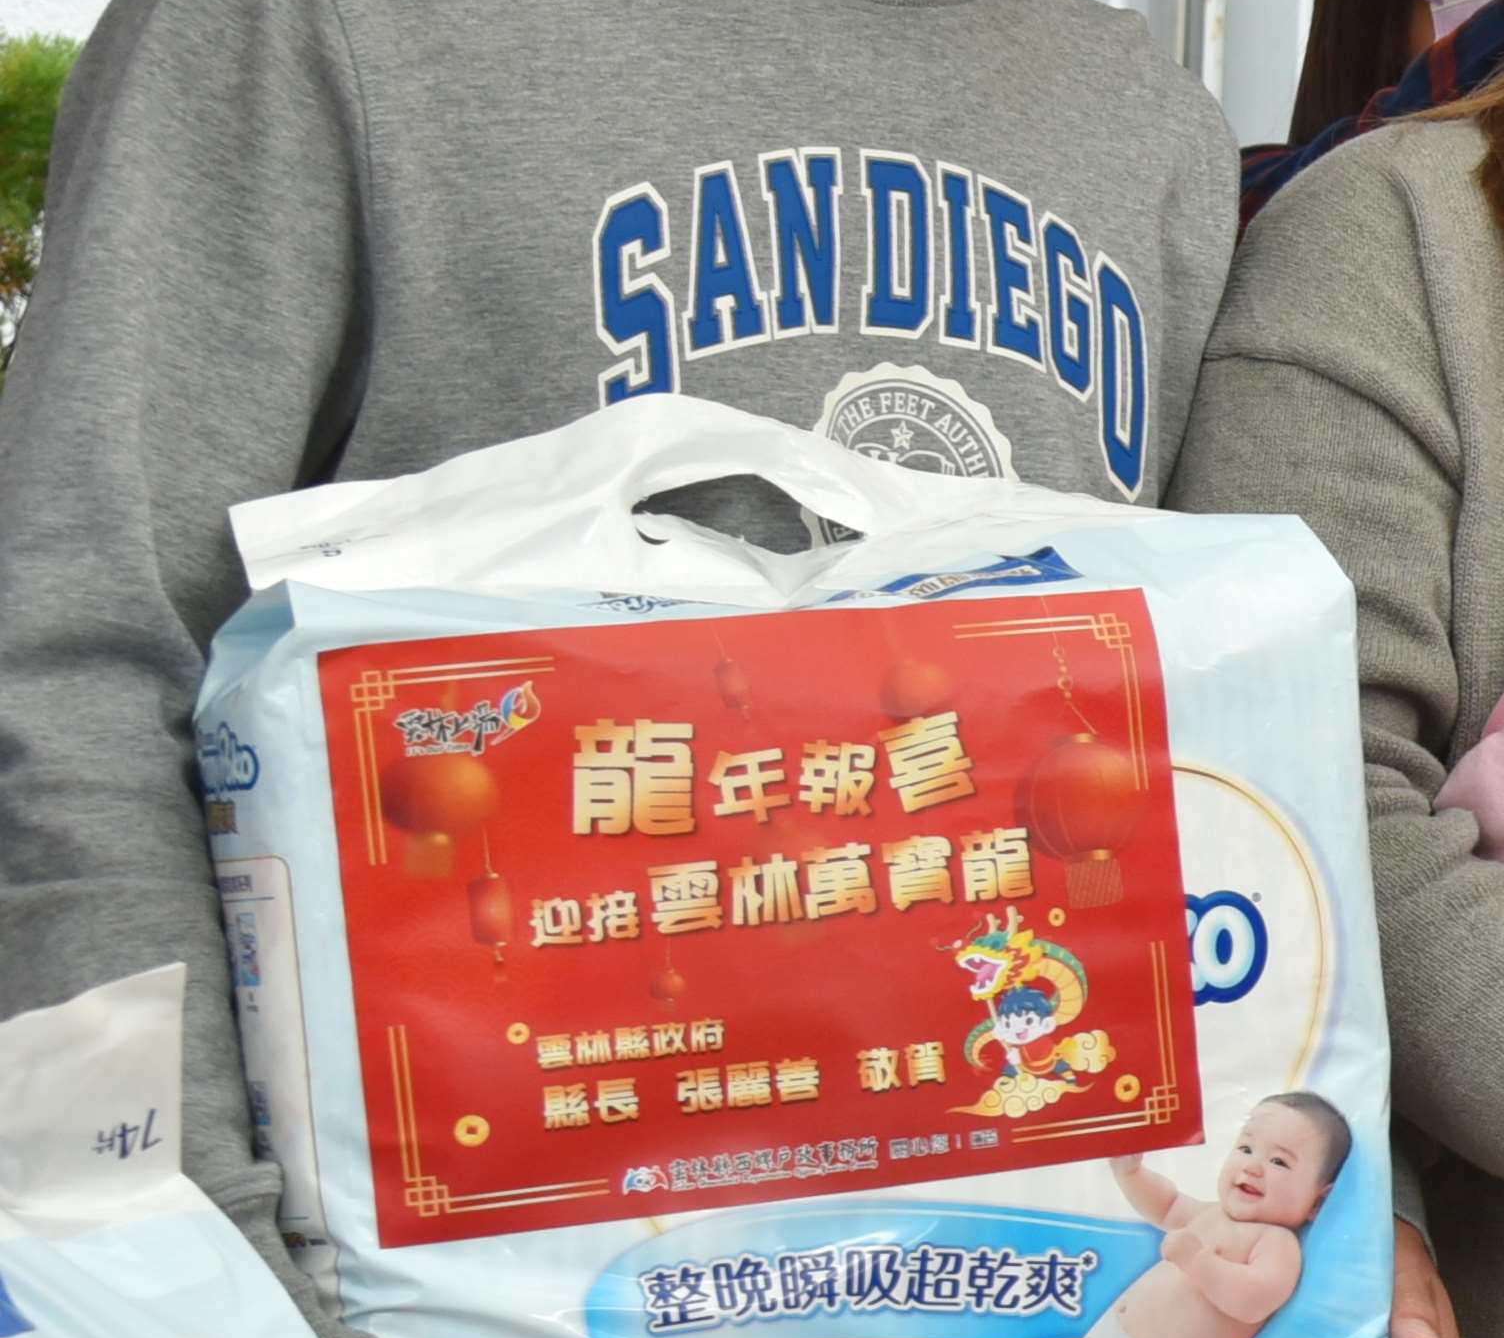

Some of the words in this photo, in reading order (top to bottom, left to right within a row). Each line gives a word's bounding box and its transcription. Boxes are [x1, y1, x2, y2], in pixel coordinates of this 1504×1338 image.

[593, 146, 843, 407] SAN
[858, 146, 1150, 503] DIEGO
[878, 390, 937, 421] FEET
[934, 412, 992, 479] AUTH
[569, 709, 978, 837] 龍年報喜
[528, 826, 1036, 950] 迎接雲林萬寶龍
[535, 1016, 726, 1070] 雲林縣政府
[541, 1078, 641, 1132] 縣長
[675, 1059, 821, 1115] 張麗善
[856, 1041, 947, 1094] 敬賀
[645, 1249, 1086, 1337] 整晚瞬吸超乾爽
